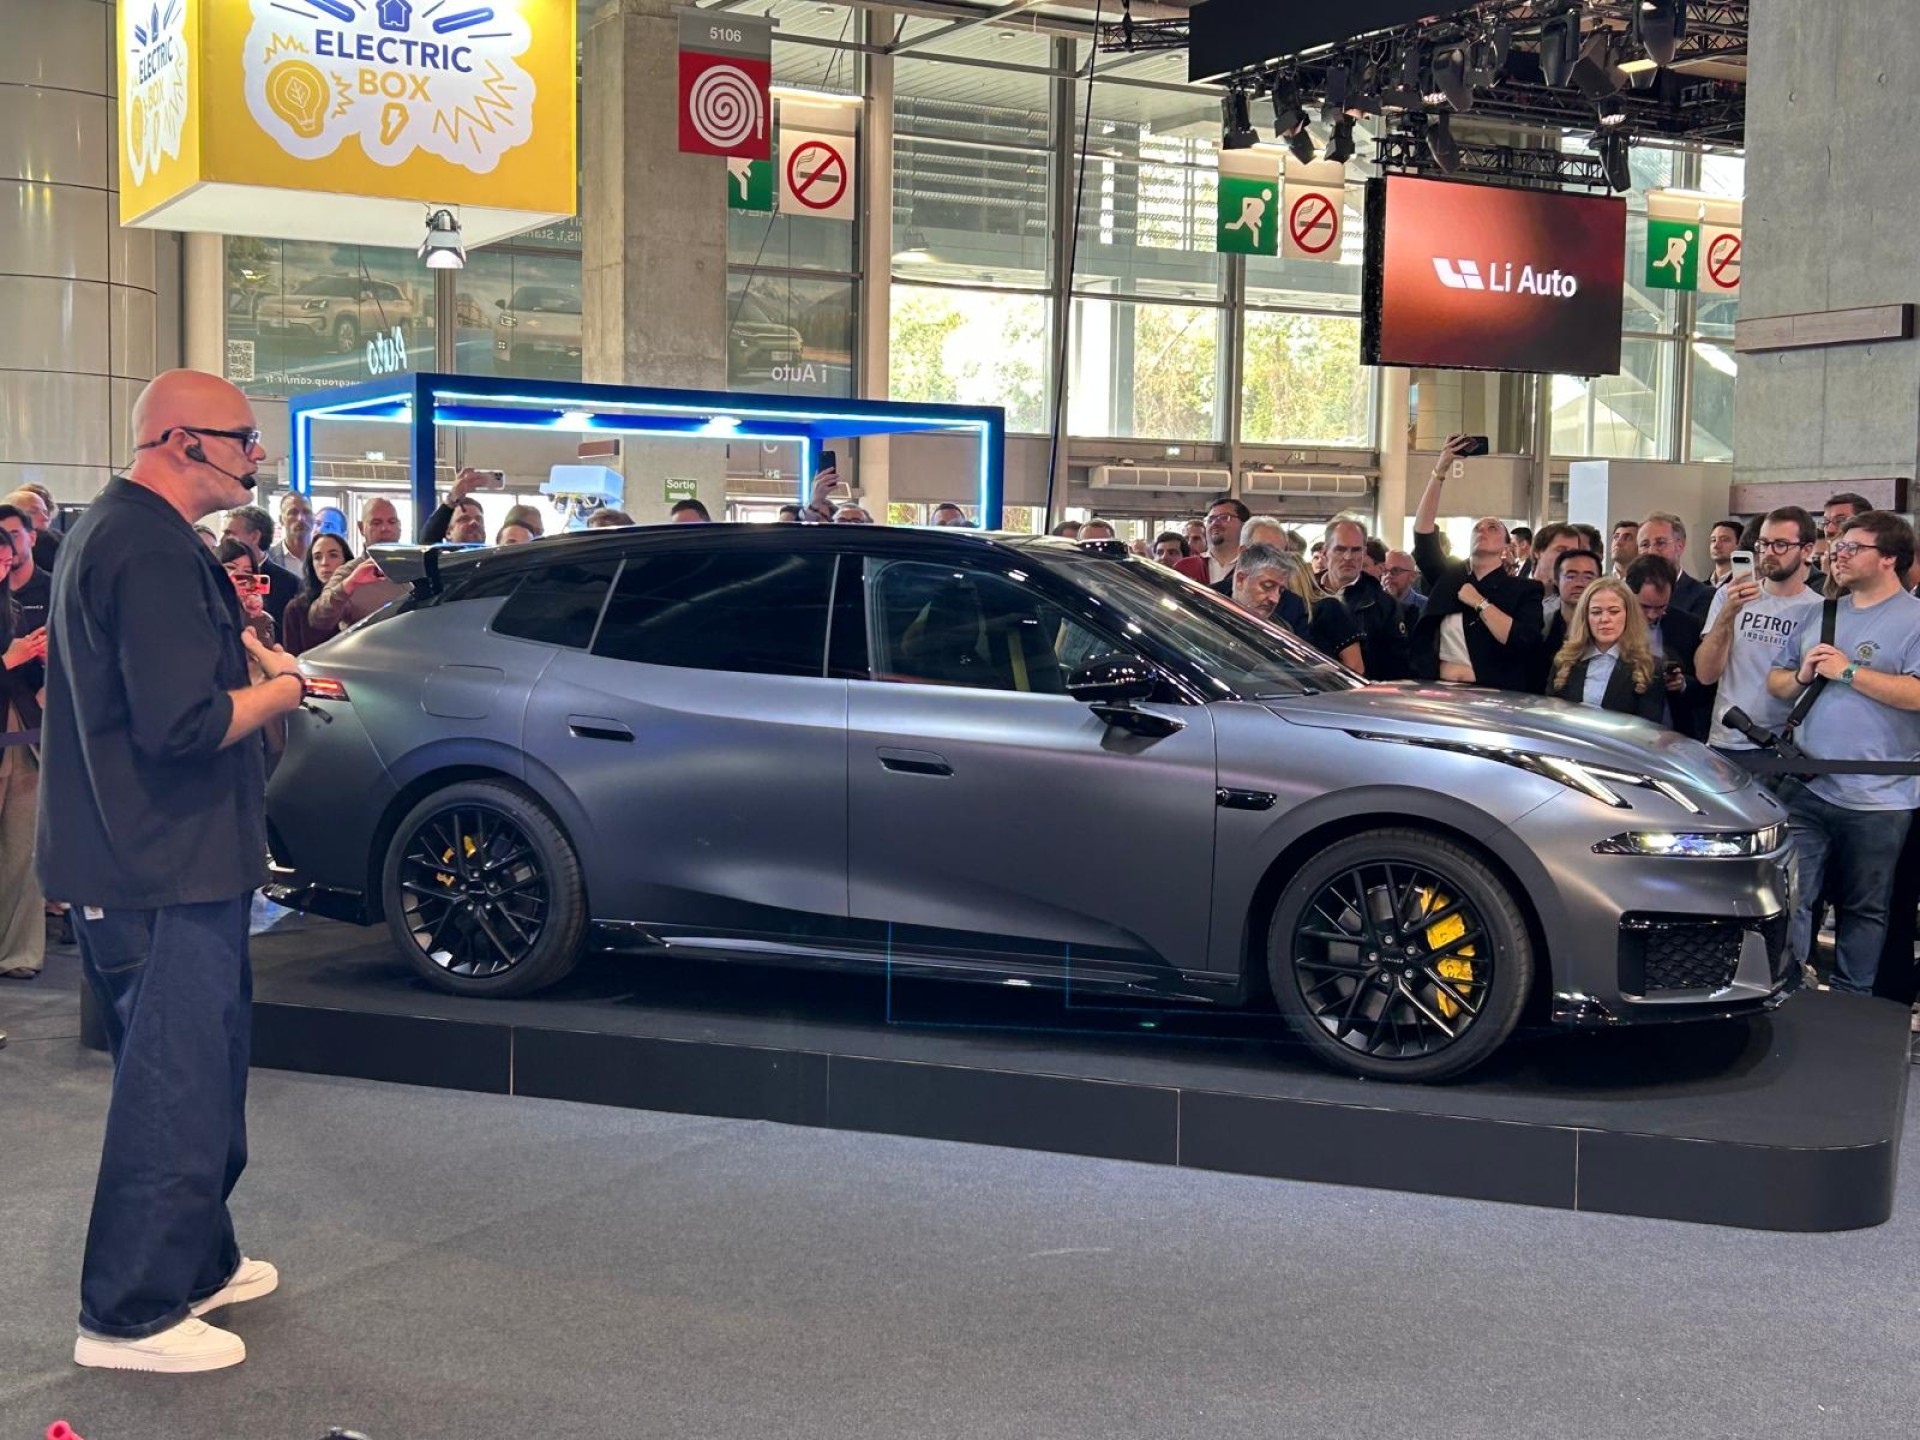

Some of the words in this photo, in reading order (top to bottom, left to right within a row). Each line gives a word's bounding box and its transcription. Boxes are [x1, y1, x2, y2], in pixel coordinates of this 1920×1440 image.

[315, 28, 473, 73] ELECTRIC
[710, 27, 742, 43] 5106
[139, 35, 173, 84] ELECTRIC
[358, 67, 431, 102] BOX
[1489, 262, 1512, 293] Li
[1517, 264, 1577, 298] Auto
[666, 479, 696, 490] Sortie
[1452, 460, 1465, 479] B
